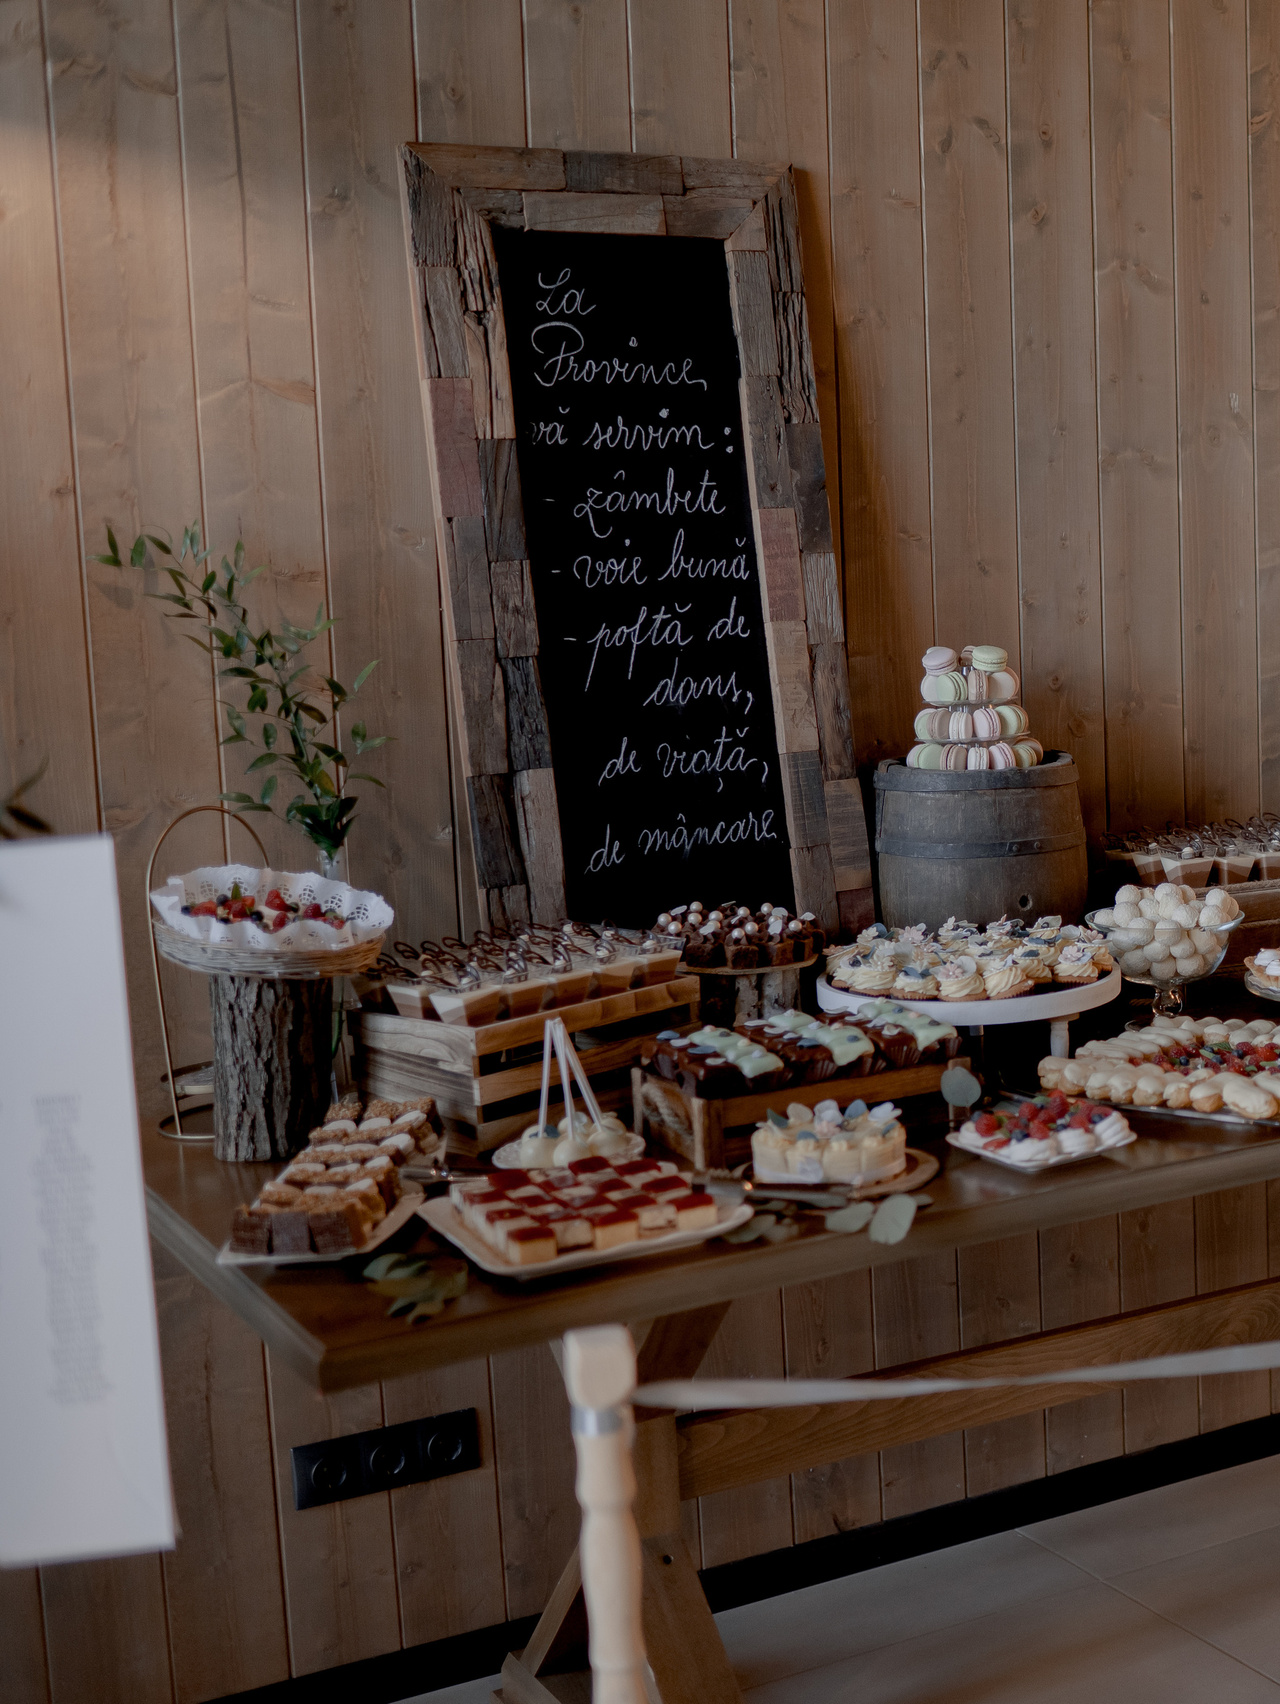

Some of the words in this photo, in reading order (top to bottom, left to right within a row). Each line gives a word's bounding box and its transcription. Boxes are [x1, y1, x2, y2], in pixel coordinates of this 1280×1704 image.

[536, 268, 596, 315] La
[574, 468, 726, 538] zâmbete
[573, 538, 647, 588] voie
[658, 528, 750, 580] bună
[585, 601, 693, 692] poftă
[707, 595, 750, 641] de
[643, 656, 753, 715] dans,
[598, 736, 641, 787] de
[584, 823, 625, 875] de
[637, 809, 777, 855] mâncare
